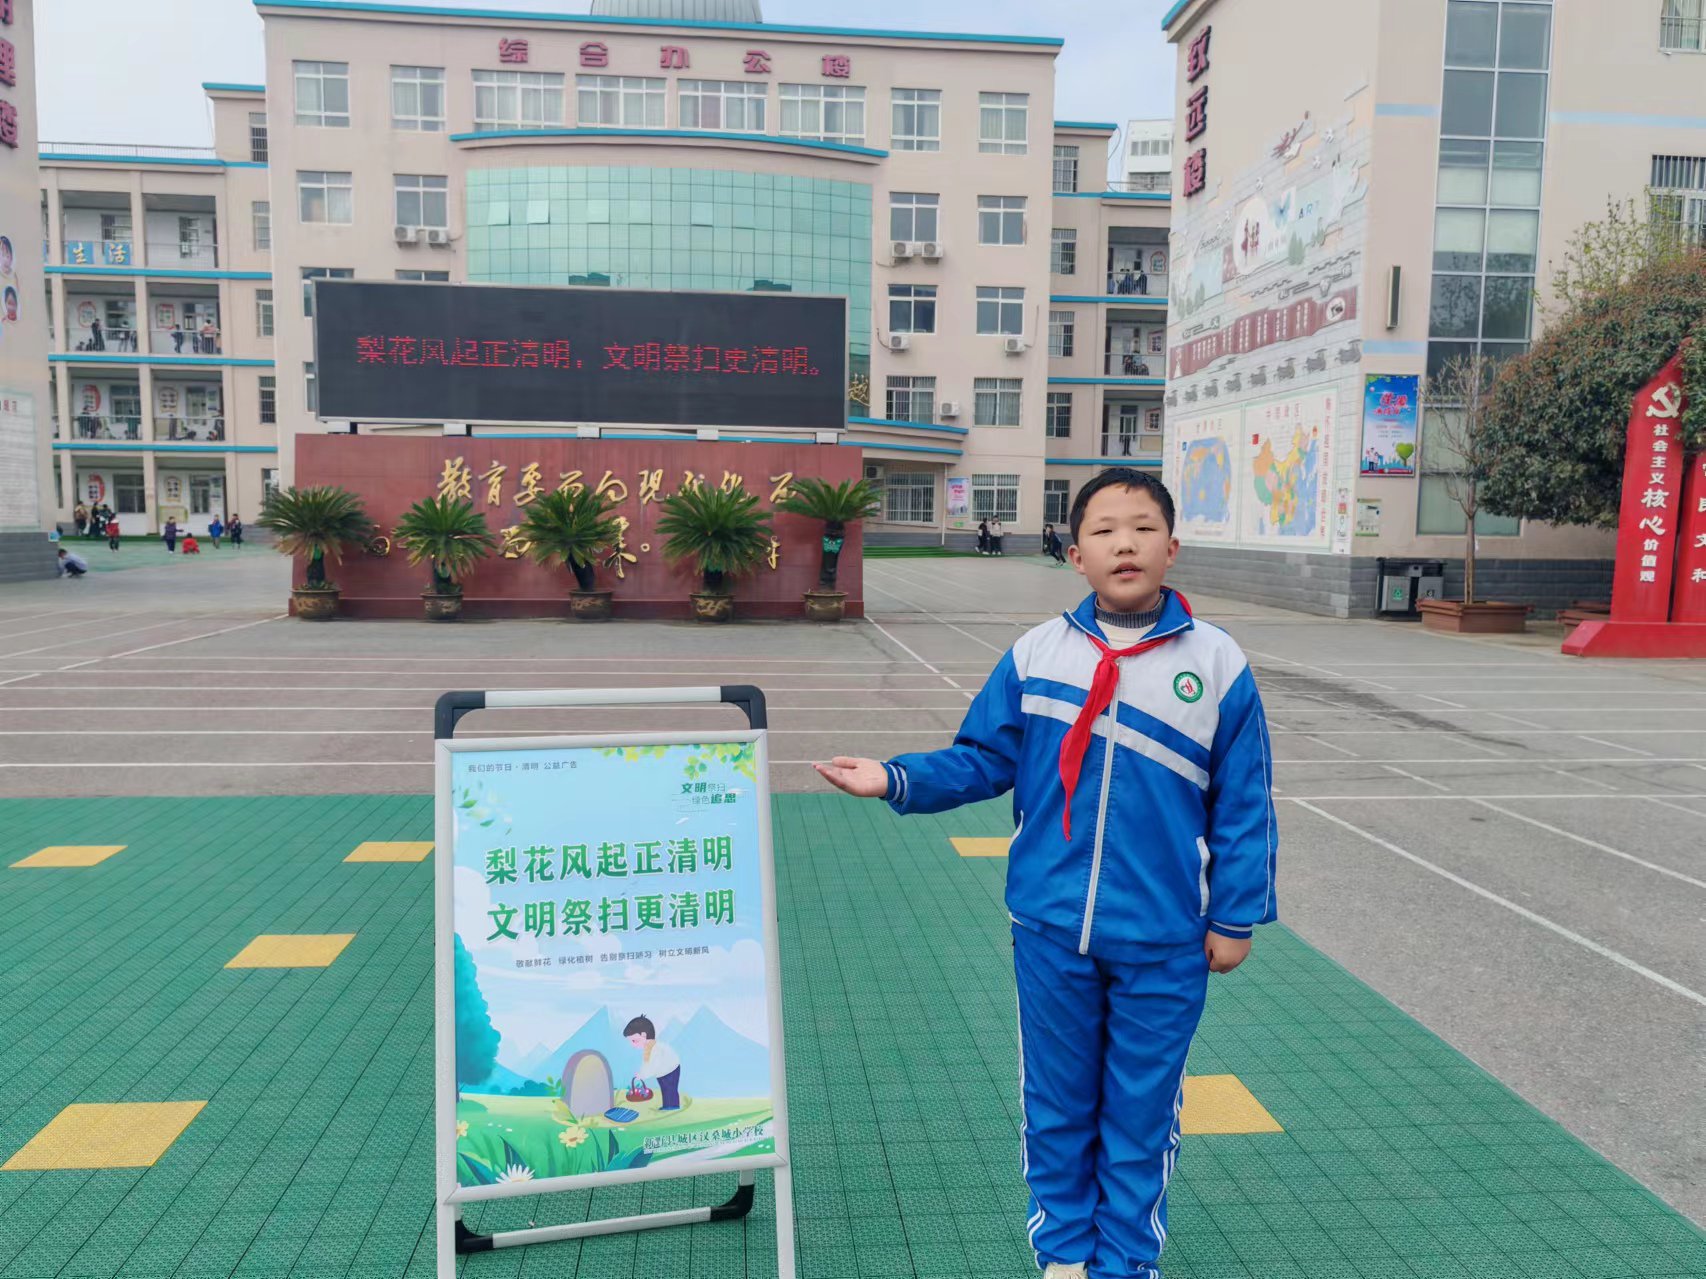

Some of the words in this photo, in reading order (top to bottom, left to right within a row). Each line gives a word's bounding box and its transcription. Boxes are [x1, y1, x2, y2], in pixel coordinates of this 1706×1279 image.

[499, 38, 851, 78] 综合办公楼
[1183, 25, 1212, 198] 致远楼
[1639, 423, 1670, 583] 社会主义核心价值观
[485, 835, 733, 885] 梨花风起正清明
[486, 888, 736, 942] 文明祭扫更清明
